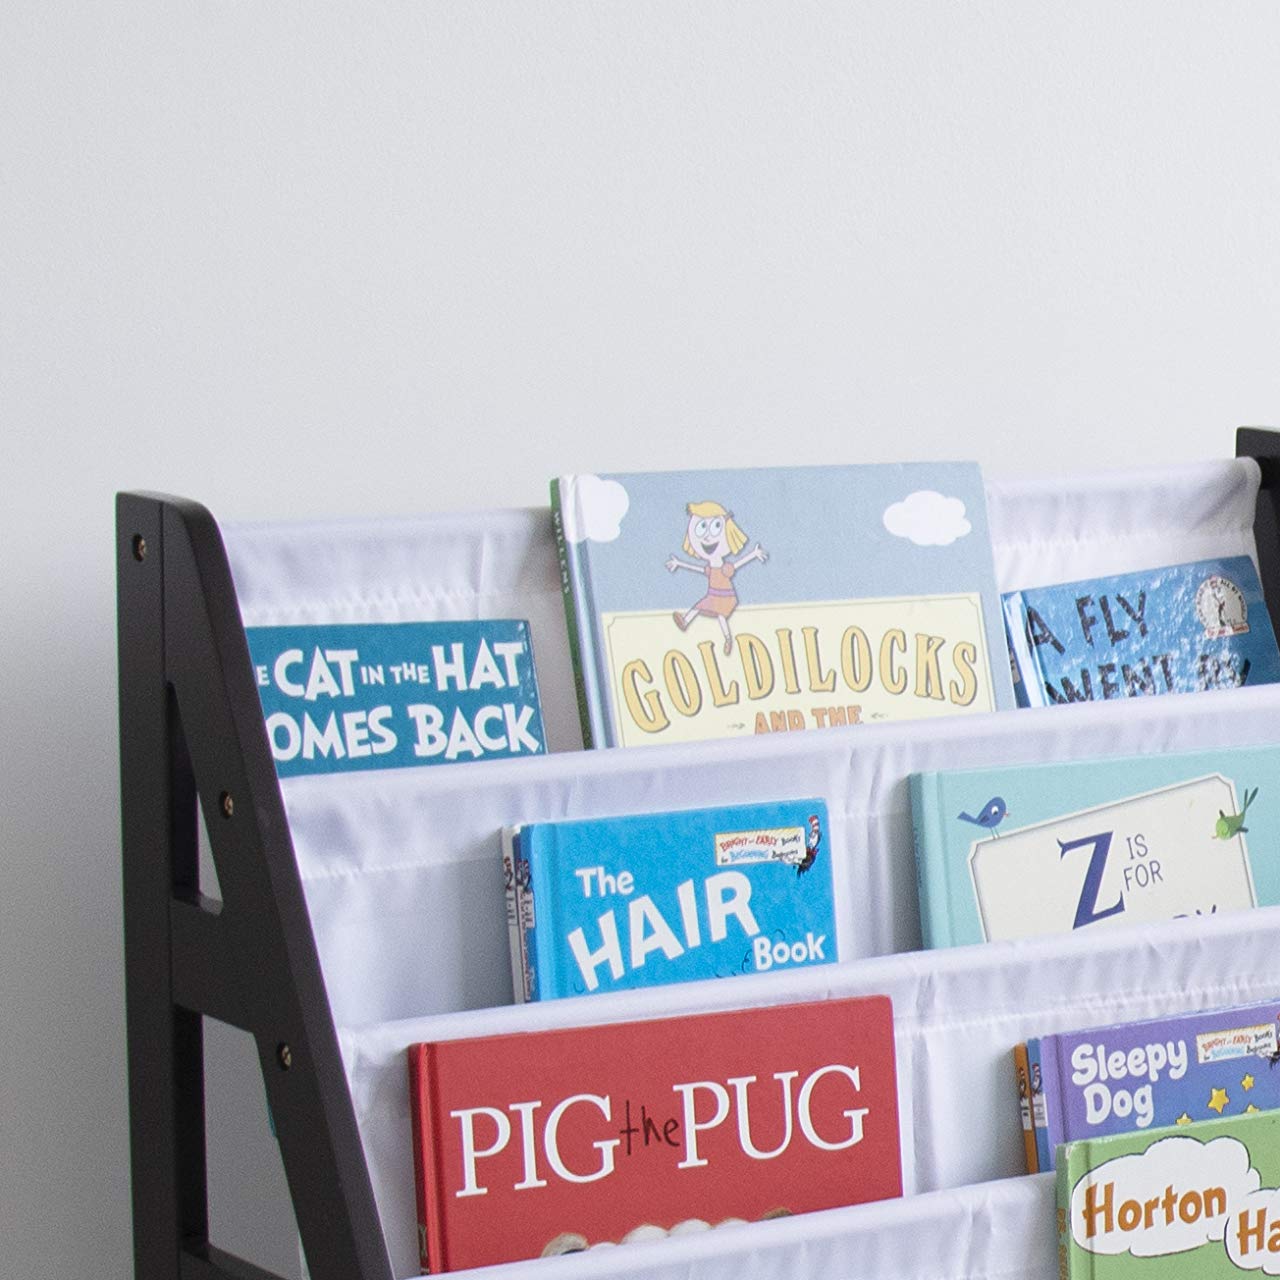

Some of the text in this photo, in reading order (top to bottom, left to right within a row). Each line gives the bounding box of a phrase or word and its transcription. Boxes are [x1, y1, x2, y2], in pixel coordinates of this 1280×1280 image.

[1025, 605, 1066, 656] A
[1075, 590, 1148, 648] FLY
[273, 646, 359, 700] CAT
[361, 665, 385, 685] IN
[390, 662, 430, 684] THE
[431, 637, 524, 691] HAT
[621, 625, 978, 734] GOLDILOCKS
[407, 703, 540, 760] BACK
[755, 710, 806, 735] AND
[1123, 860, 1164, 892] FOR
[1126, 834, 1150, 861] IS
[575, 865, 635, 899] The
[1056, 830, 1126, 931] Z
[567, 870, 761, 992] HAIR
[754, 931, 826, 972] Book
[1071, 1039, 1188, 1086] Sleepy
[450, 1064, 870, 1199] PIG the PUG
[1083, 1083, 1155, 1128] Dog
[1082, 1181, 1228, 1240] Horton
